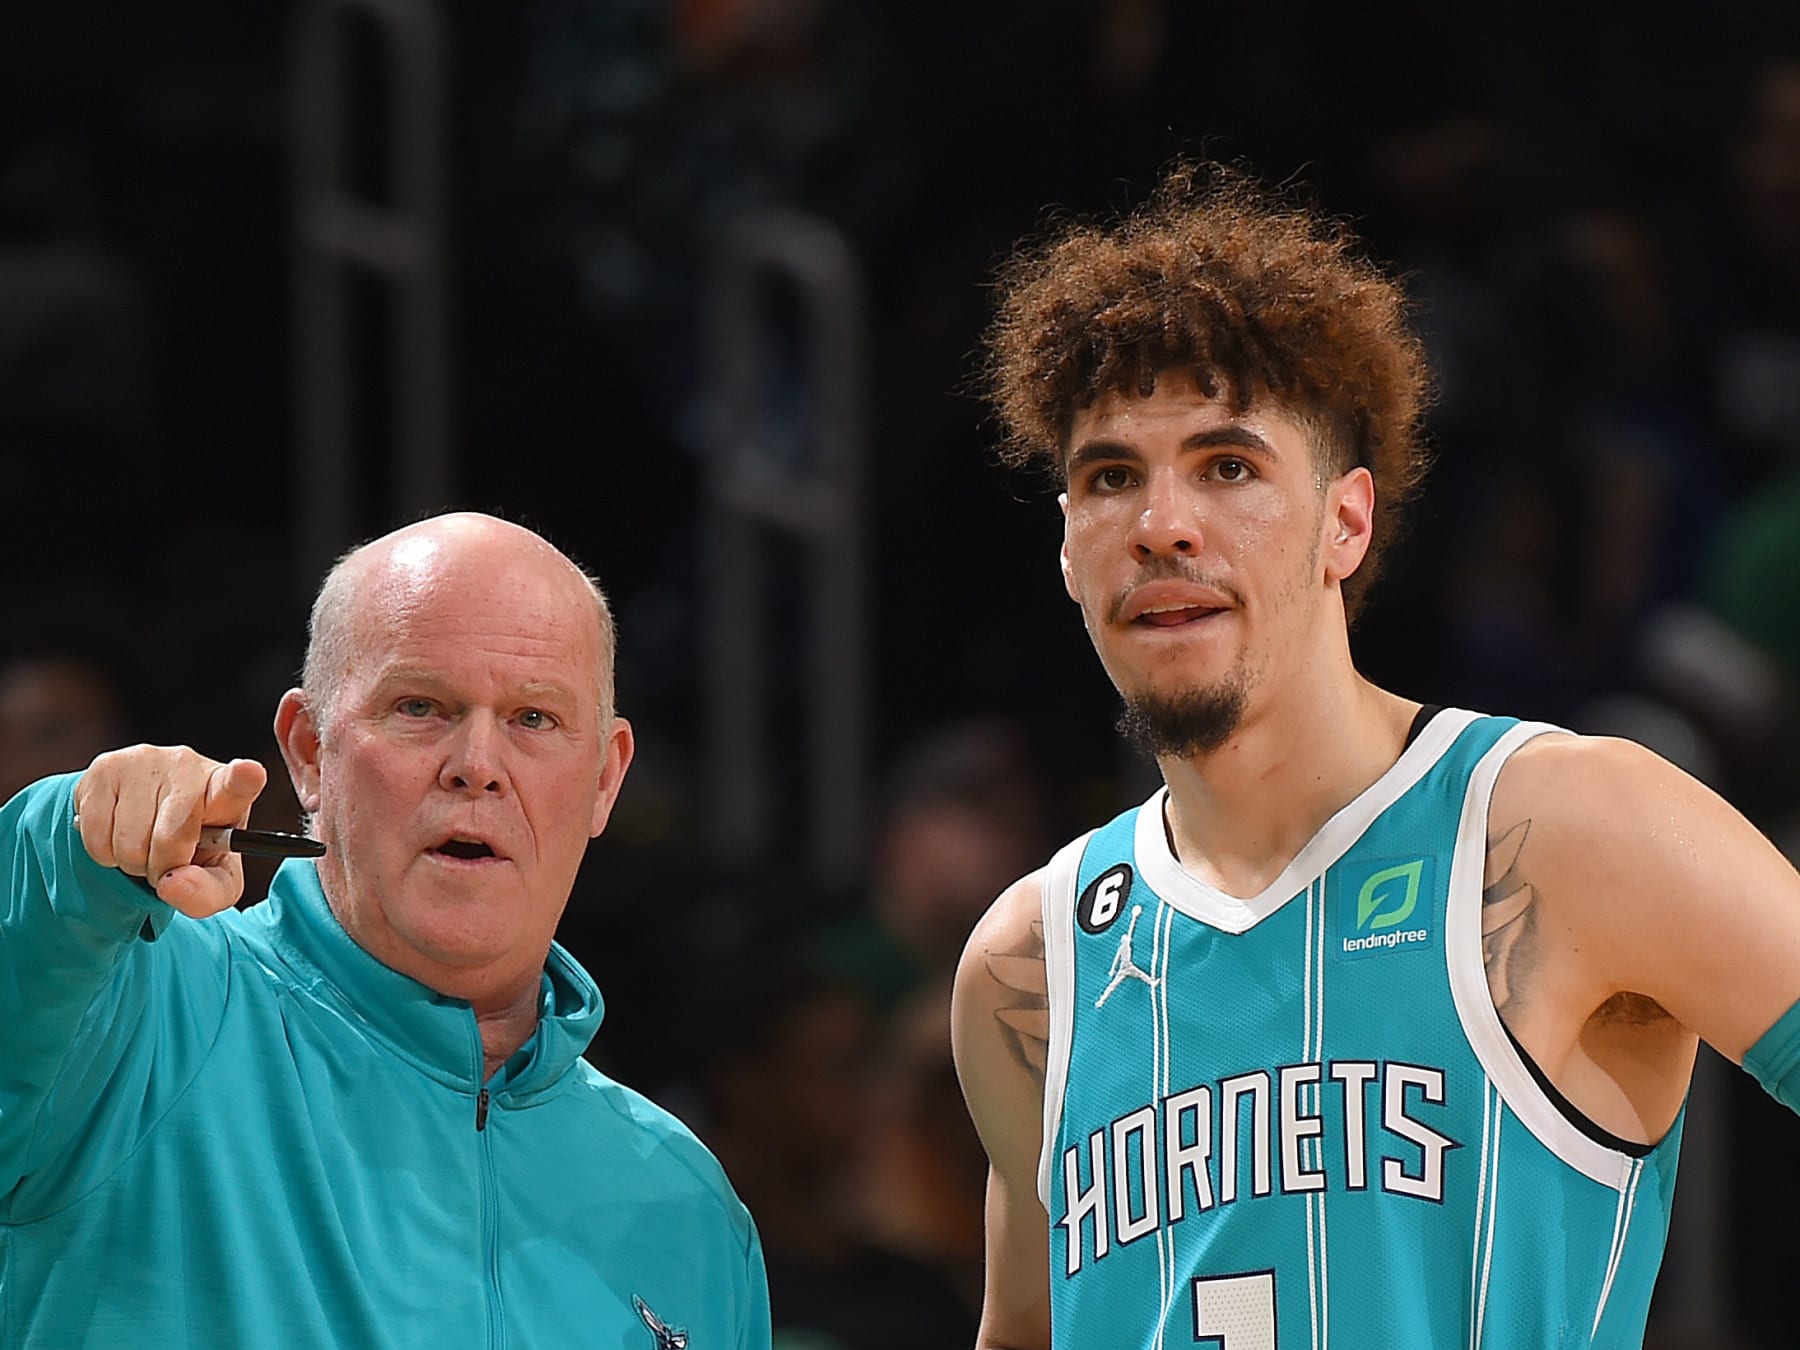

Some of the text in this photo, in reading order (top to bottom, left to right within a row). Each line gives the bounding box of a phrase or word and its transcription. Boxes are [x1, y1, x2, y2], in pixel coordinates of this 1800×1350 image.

[1090, 866, 1126, 928] 6
[1343, 929, 1428, 952] lendingtree
[1056, 1059, 1463, 1279] HORNETS
